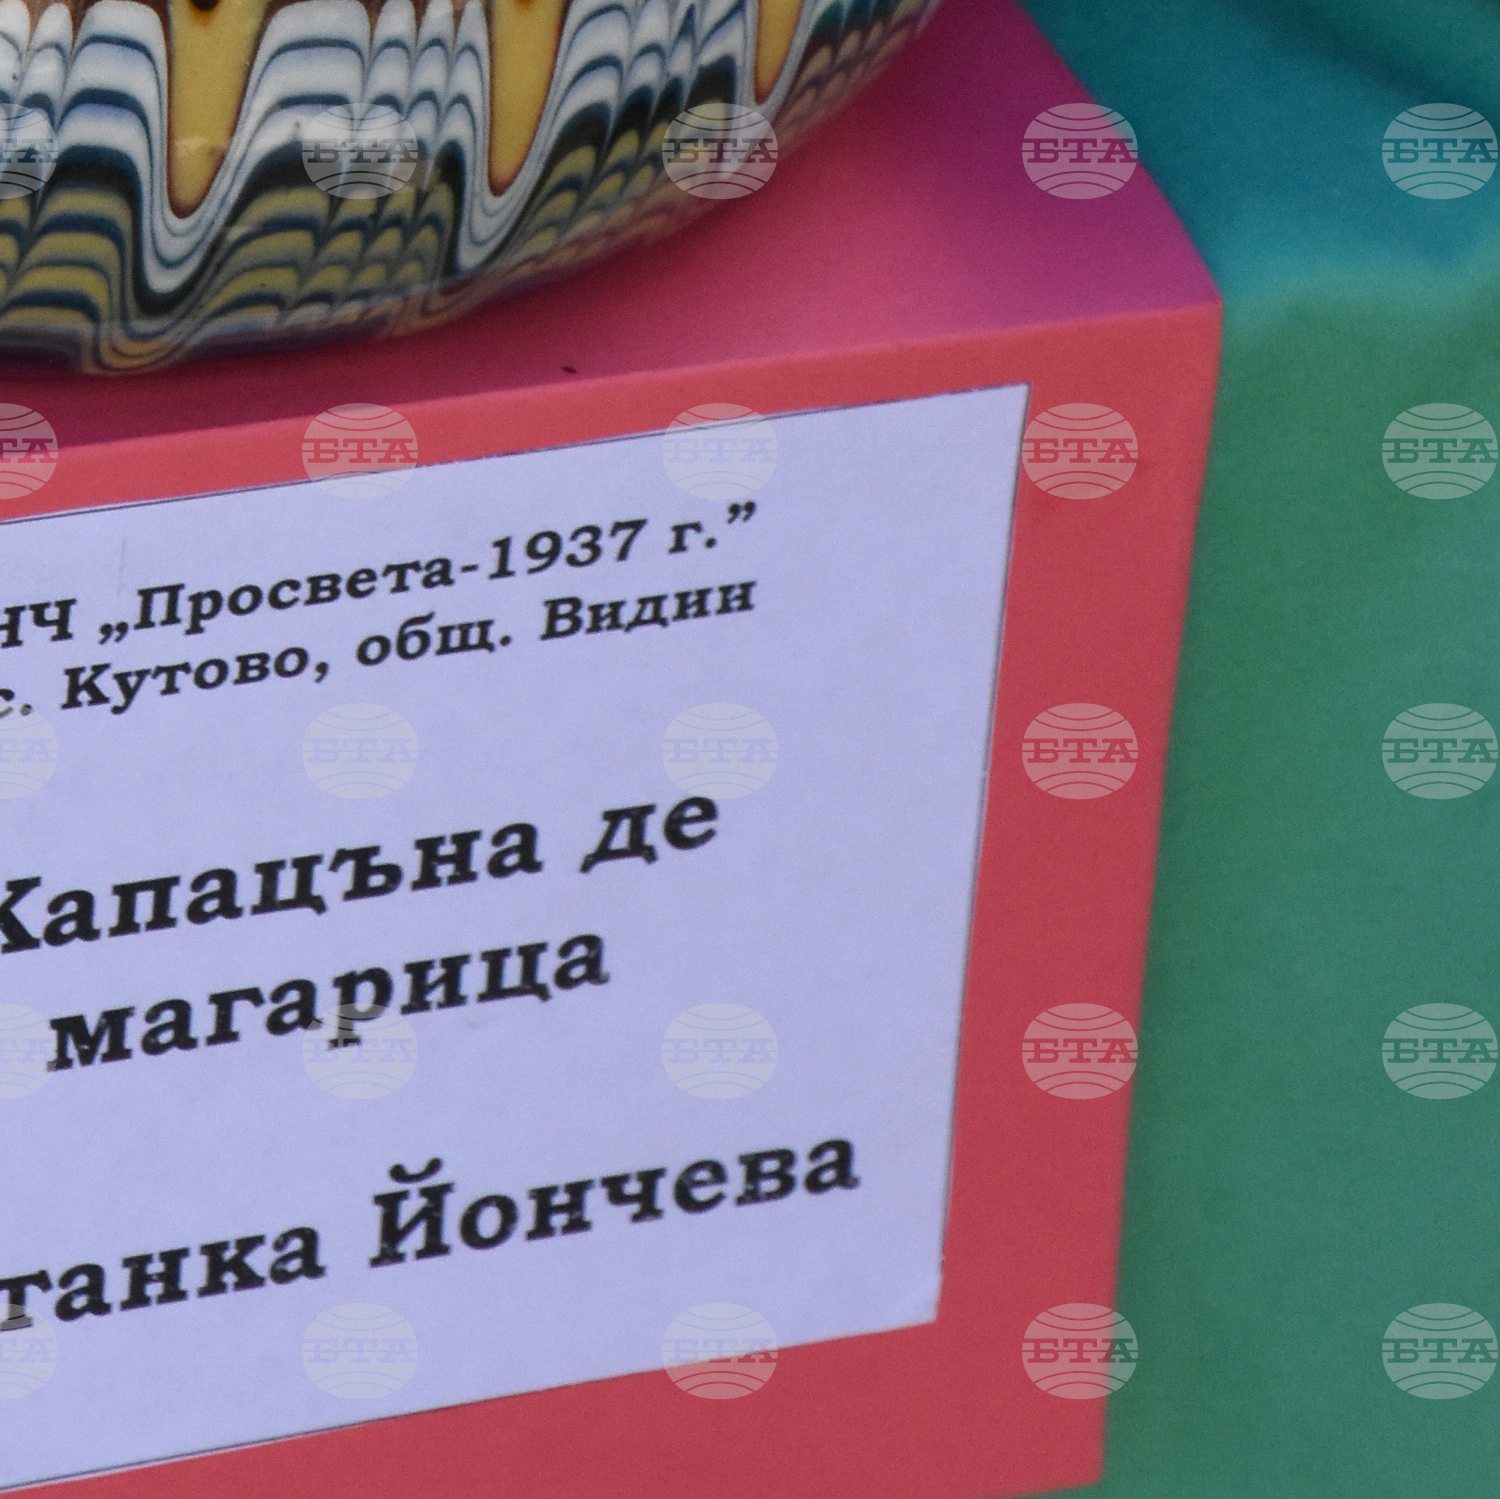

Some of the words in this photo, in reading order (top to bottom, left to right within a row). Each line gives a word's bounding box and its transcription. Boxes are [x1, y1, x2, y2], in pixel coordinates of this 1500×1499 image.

[60, 646, 329, 716] Кутово,
[356, 611, 512, 667] общ.
[539, 580, 757, 641] Видин
[579, 795, 719, 874] де
[47, 933, 610, 1072] магарица
[369, 1138, 861, 1269] Йончева
